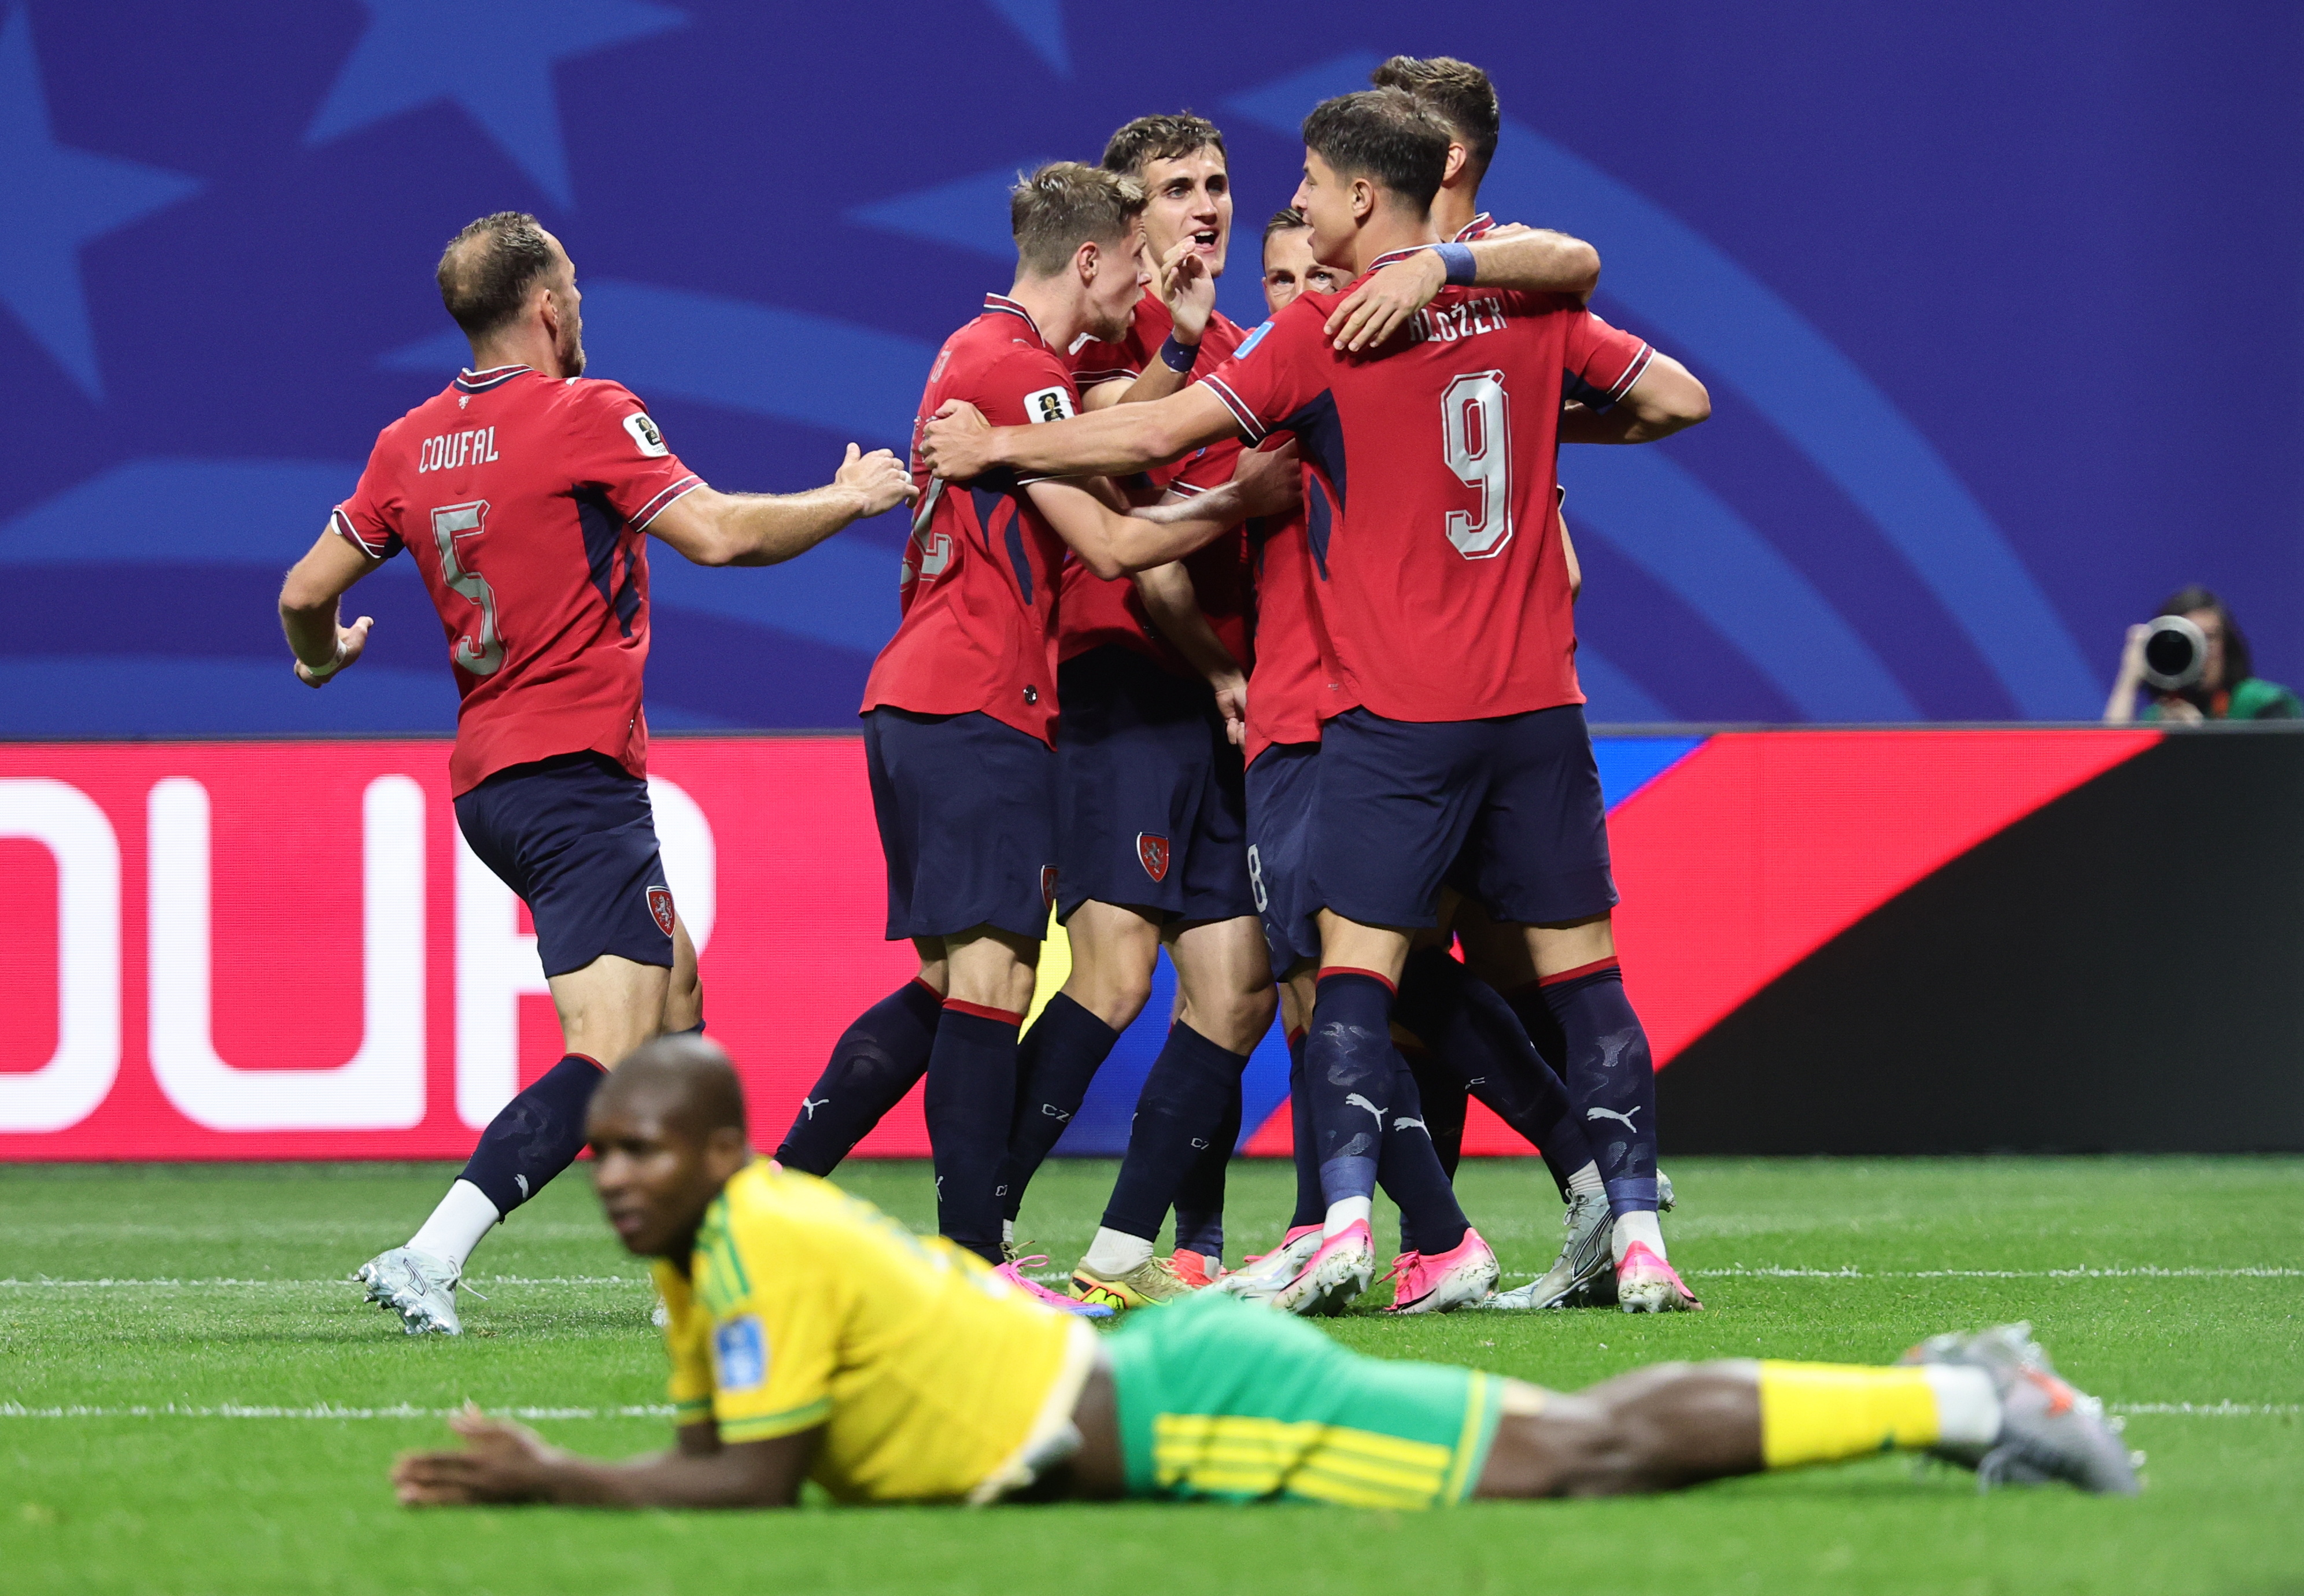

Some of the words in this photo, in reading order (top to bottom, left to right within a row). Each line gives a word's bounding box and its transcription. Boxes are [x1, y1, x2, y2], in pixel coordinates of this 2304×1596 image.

[419, 426, 499, 474] COUFAL
[1441, 369, 1513, 560] 9
[431, 499, 509, 675] 5
[1247, 844, 1268, 913] 8
[1042, 1103, 1073, 1123] CZ
